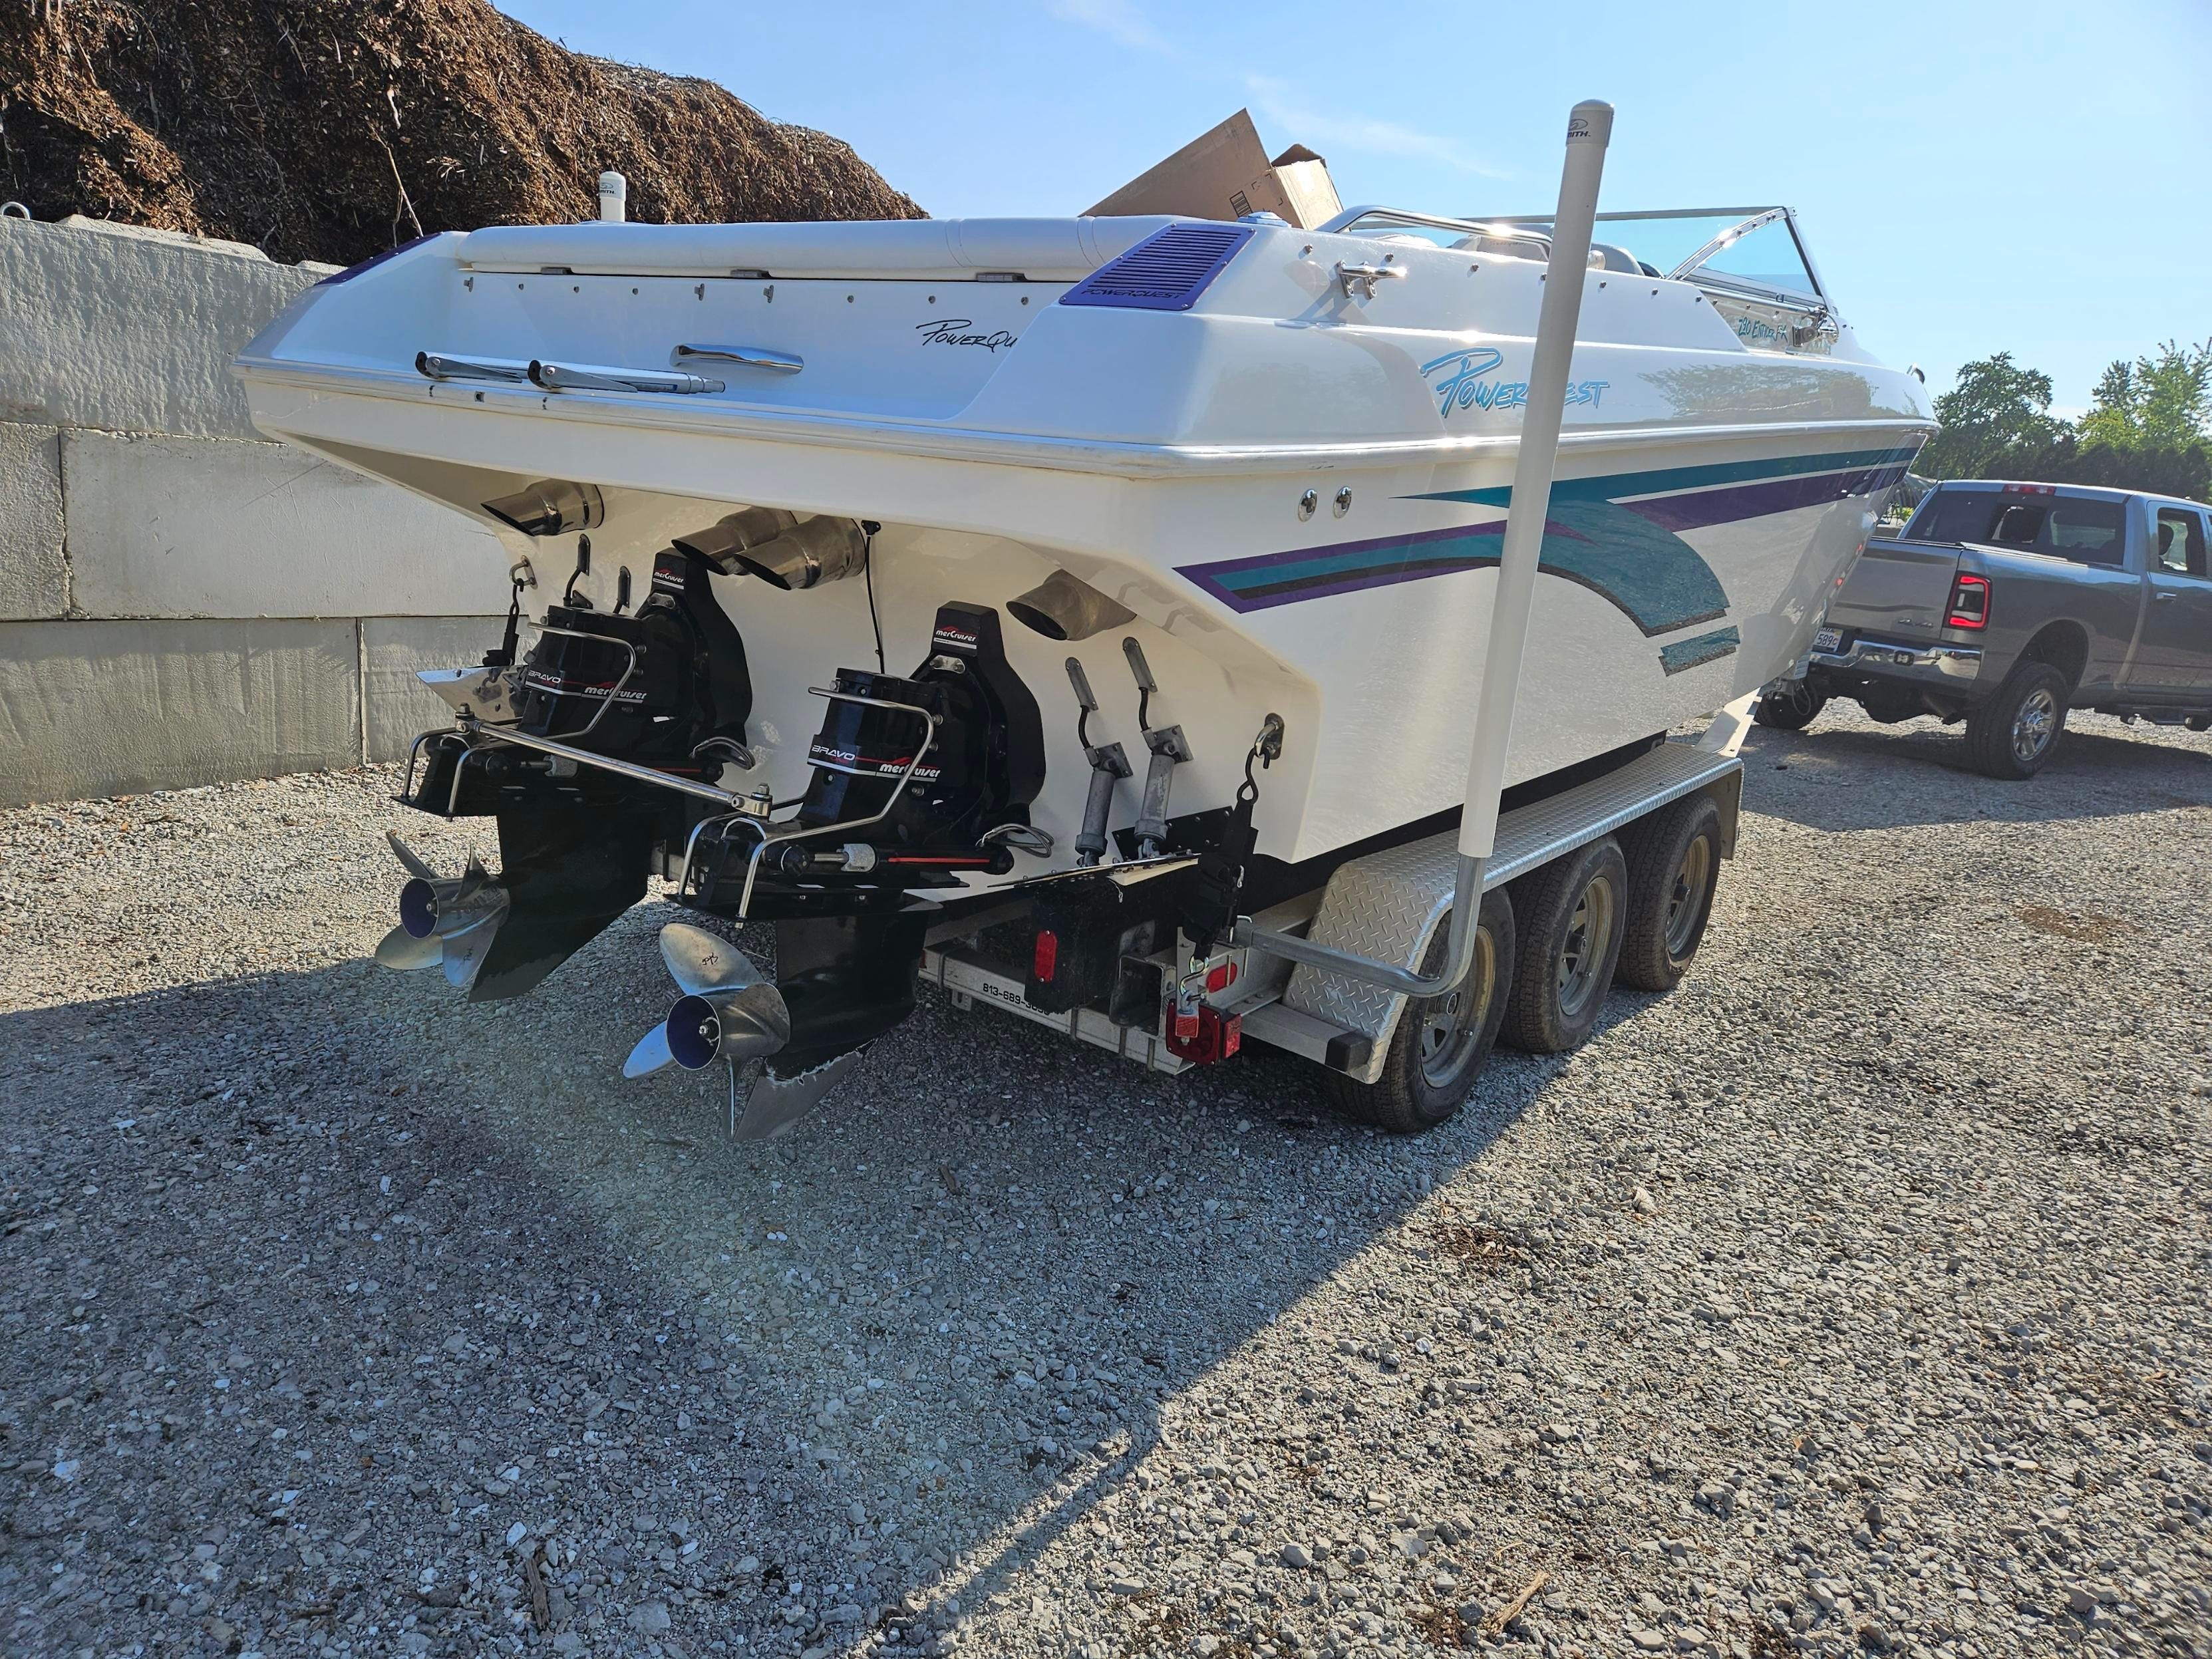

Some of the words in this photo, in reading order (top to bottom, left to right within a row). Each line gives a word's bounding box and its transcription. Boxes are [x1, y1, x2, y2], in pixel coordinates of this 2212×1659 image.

[1080, 289, 1187, 299] POWERQUEST
[1420, 347, 1611, 418] POWEREST
[935, 629, 977, 642] merCruiser
[528, 670, 561, 684] BRAVO
[812, 744, 856, 761] BRAVO
[879, 763, 941, 778] meruiser
